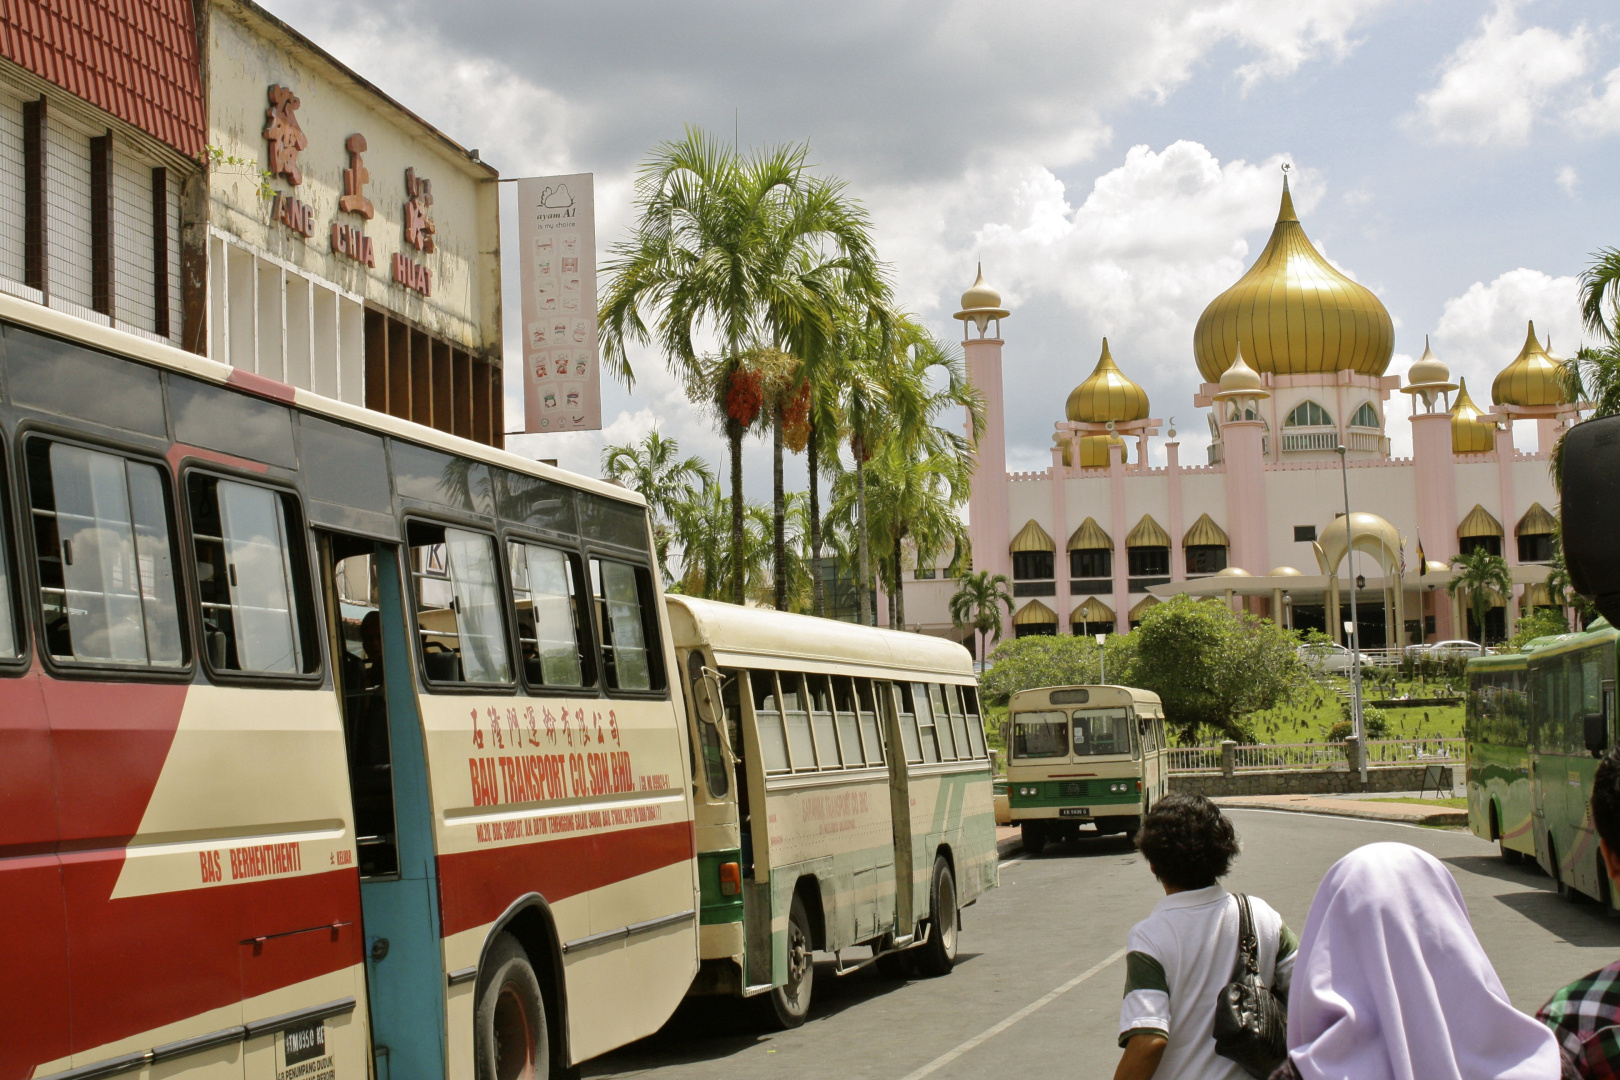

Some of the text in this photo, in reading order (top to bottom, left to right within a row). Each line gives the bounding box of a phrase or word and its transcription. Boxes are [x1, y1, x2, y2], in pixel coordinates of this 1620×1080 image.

[536, 207, 576, 222] ayam A1
[330, 223, 375, 268] CHIA
[391, 252, 433, 297] HUAT
[469, 757, 499, 806] BAU
[499, 754, 568, 804] TRANSPORT
[199, 850, 222, 883] BAS
